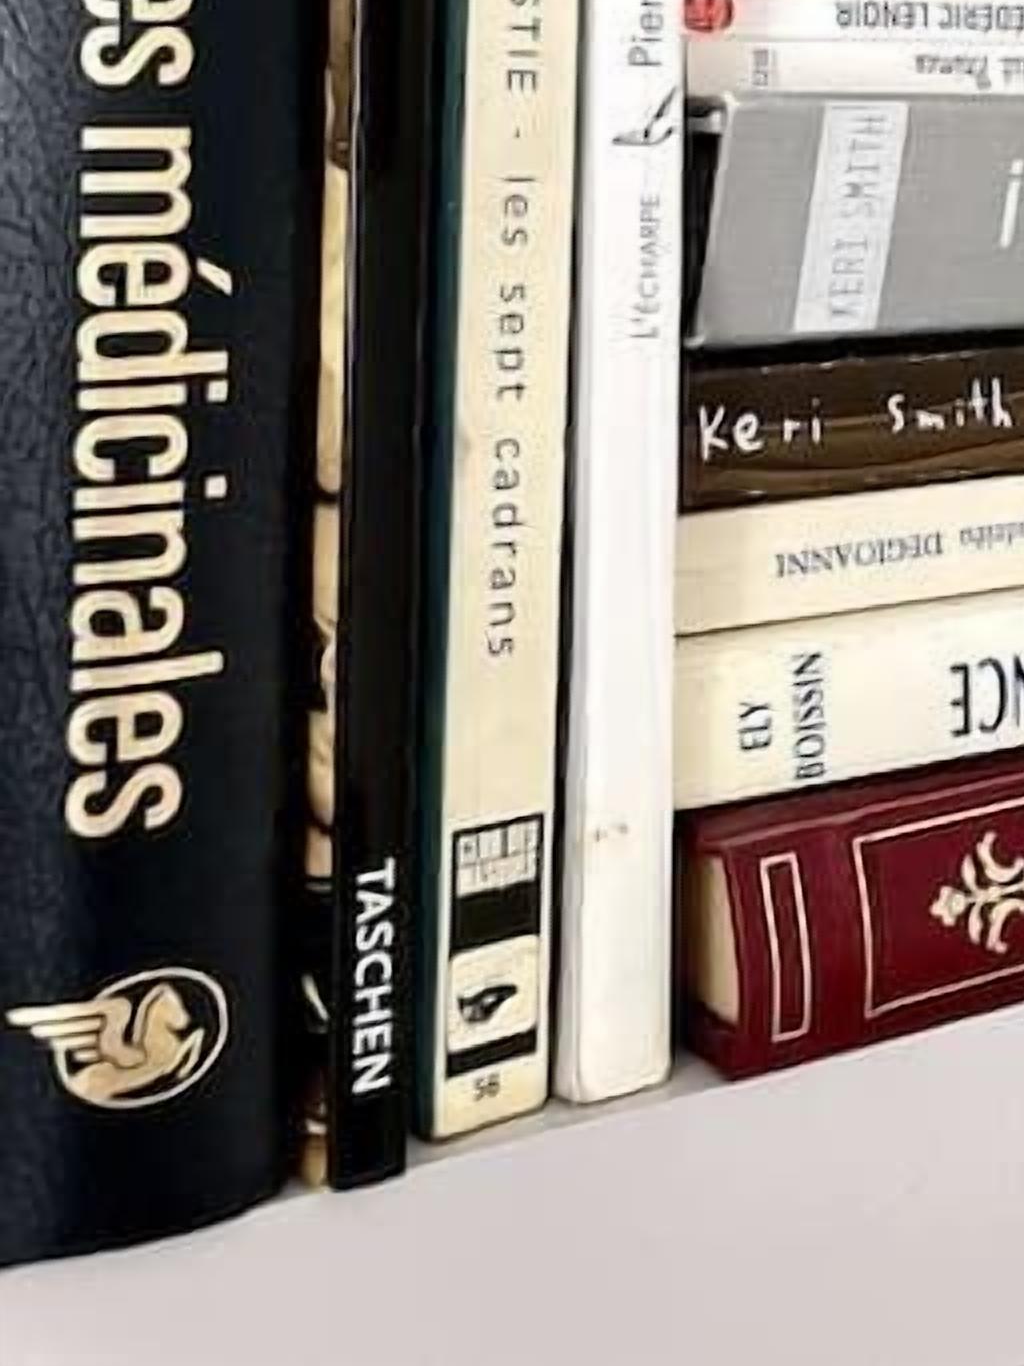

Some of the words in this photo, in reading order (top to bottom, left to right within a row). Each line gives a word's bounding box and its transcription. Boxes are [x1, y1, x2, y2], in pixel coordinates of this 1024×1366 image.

[497, 177, 537, 248] les
[492, 281, 529, 403] sept
[887, 376, 1014, 435] Smith
[65, 124, 233, 837] médicinales
[487, 438, 523, 657] cadrans
[738, 701, 774, 752] ELY
[792, 650, 826, 781] BOISSIN
[352, 857, 395, 1096] TASCHEN
